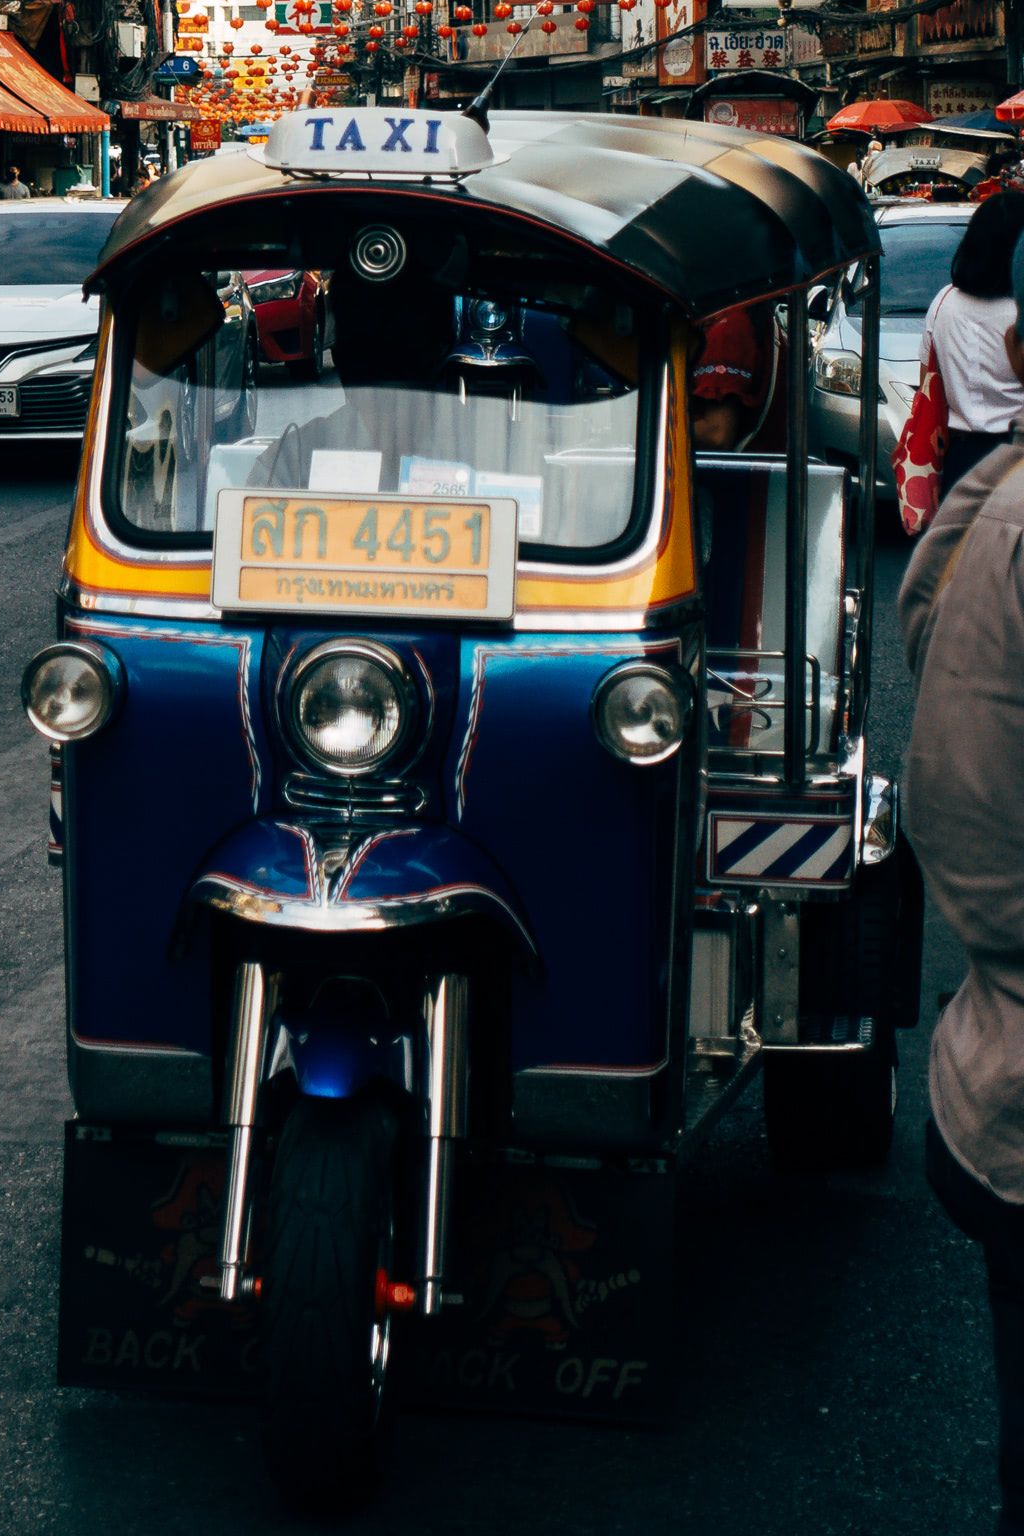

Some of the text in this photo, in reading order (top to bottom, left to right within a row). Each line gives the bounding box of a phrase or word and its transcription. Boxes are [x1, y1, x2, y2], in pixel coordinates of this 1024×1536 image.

[182, 60, 190, 71] 6
[304, 116, 442, 154] TAXI
[431, 481, 467, 496] 2565
[352, 506, 483, 565] 4451
[276, 573, 456, 603] กรุงเทพมหานคร
[79, 1325, 207, 1373] BACK
[429, 1346, 649, 1401] ACK OFF
